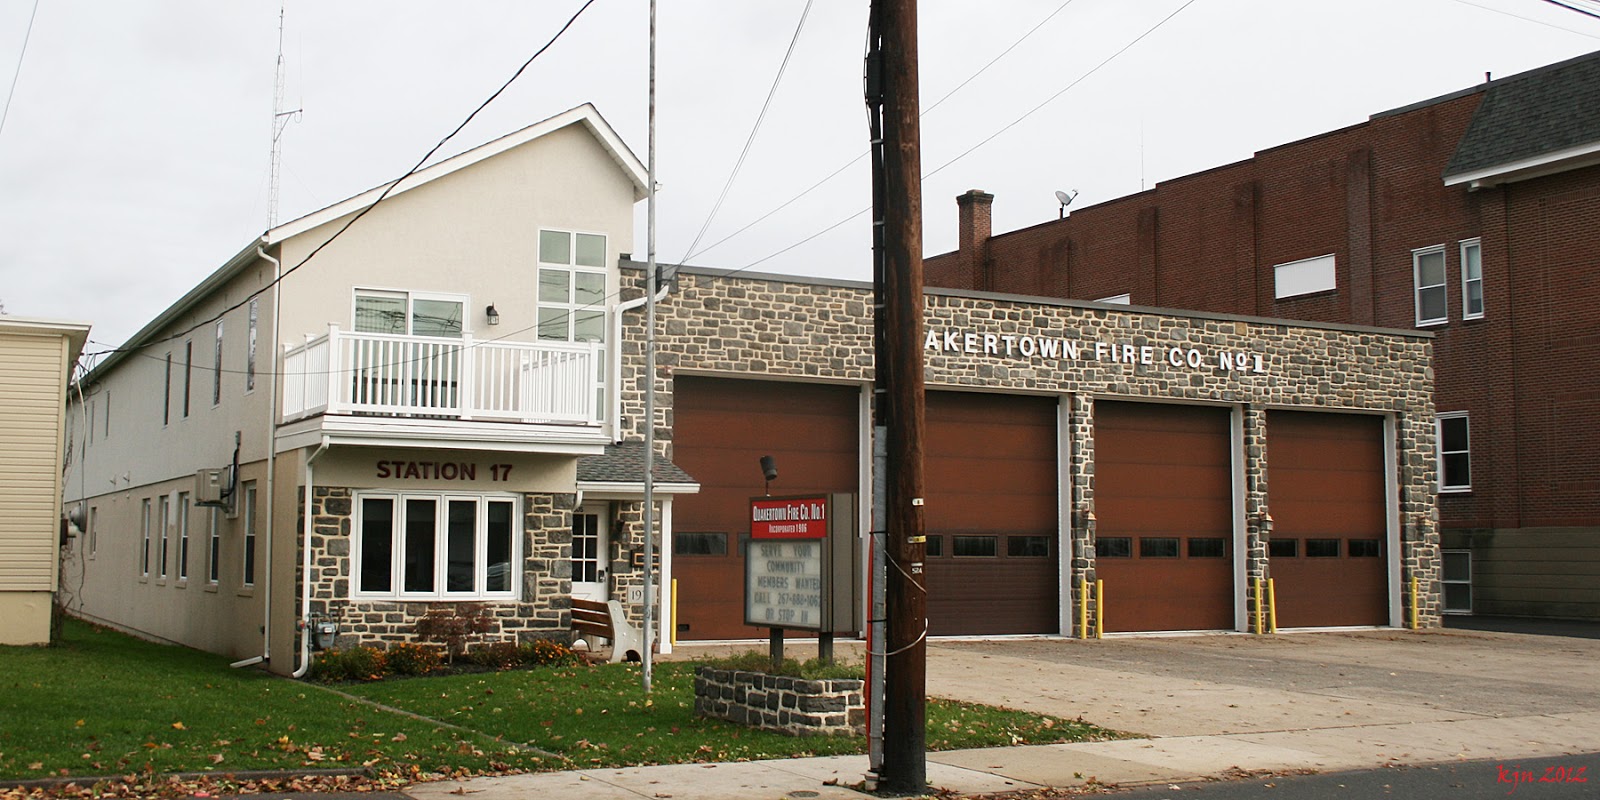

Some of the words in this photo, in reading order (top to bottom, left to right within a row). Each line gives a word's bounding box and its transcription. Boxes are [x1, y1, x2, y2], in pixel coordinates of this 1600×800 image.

[924, 330, 1077, 359] AKERTOWN
[1095, 342, 1153, 365] FIRE
[1169, 347, 1205, 368] CO.
[377, 460, 476, 480] STATION
[490, 464, 513, 481] 17
[761, 544, 782, 557] SERVE
[793, 544, 812, 558] YOUR
[767, 560, 805, 573] COMMUNITY
[757, 576, 789, 589] MEMBERS
[795, 577, 820, 590] WANTED
[754, 592, 771, 604] CALL
[766, 607, 775, 621] OR
[778, 608, 795, 621] STOP
